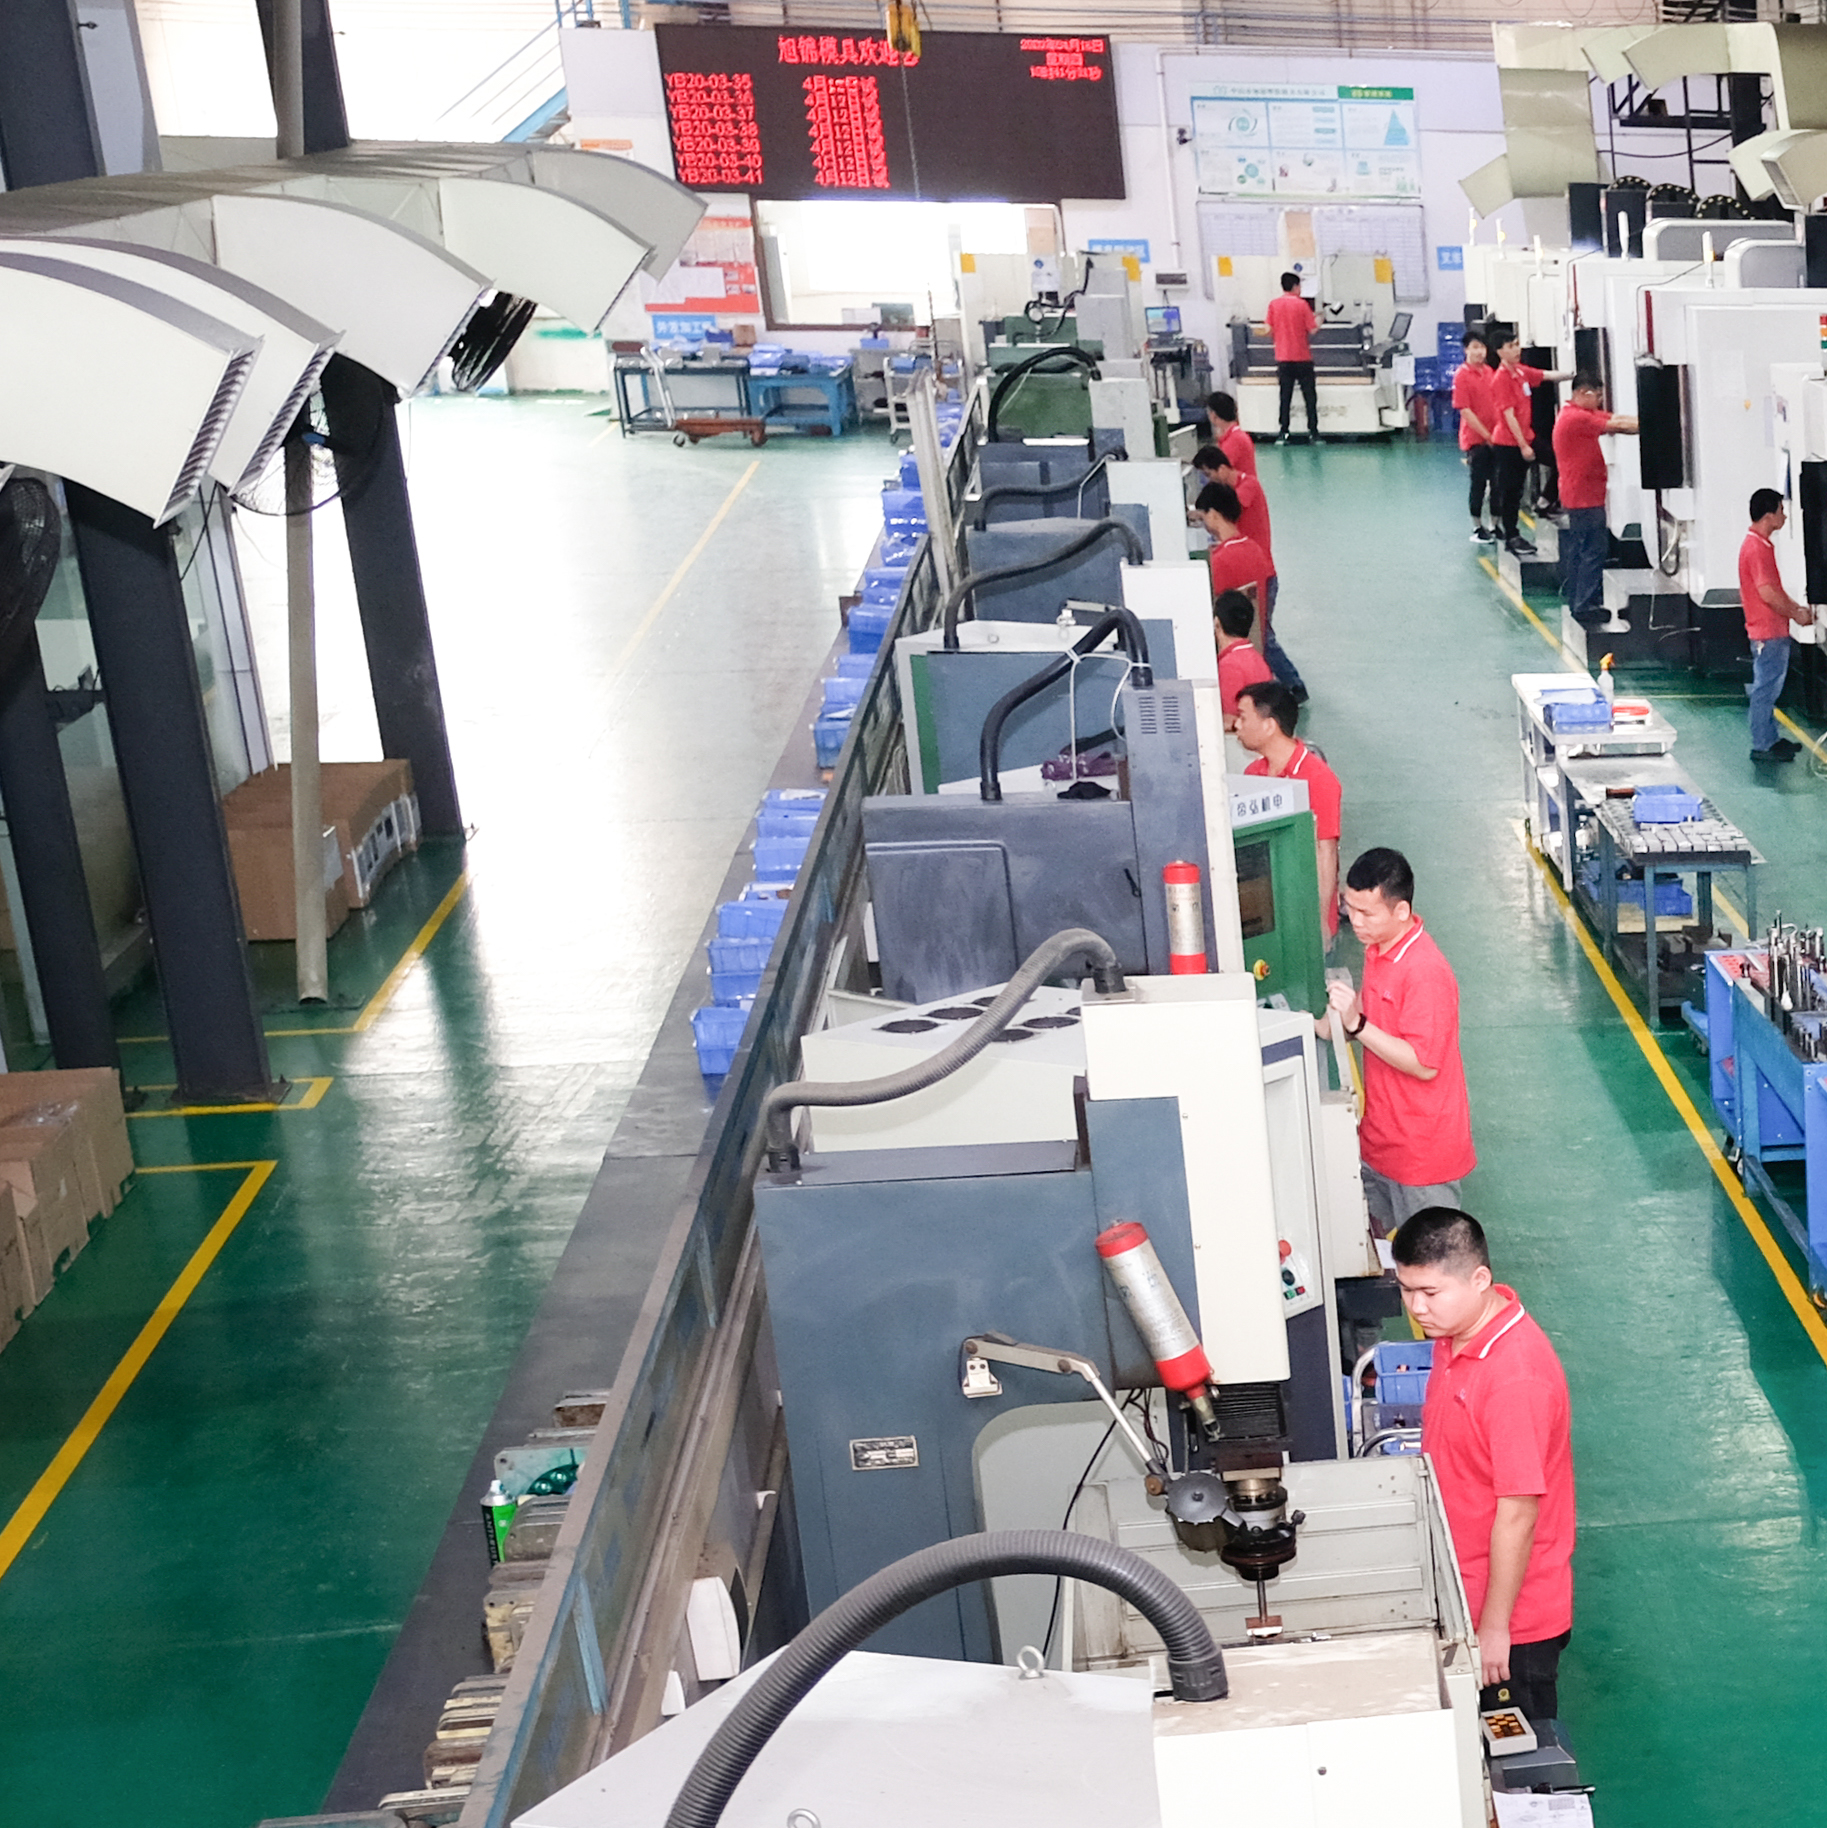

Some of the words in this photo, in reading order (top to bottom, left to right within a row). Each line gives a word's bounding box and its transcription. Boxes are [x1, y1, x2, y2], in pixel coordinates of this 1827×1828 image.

[778, 35, 919, 67] 旭锦模具欢迎
